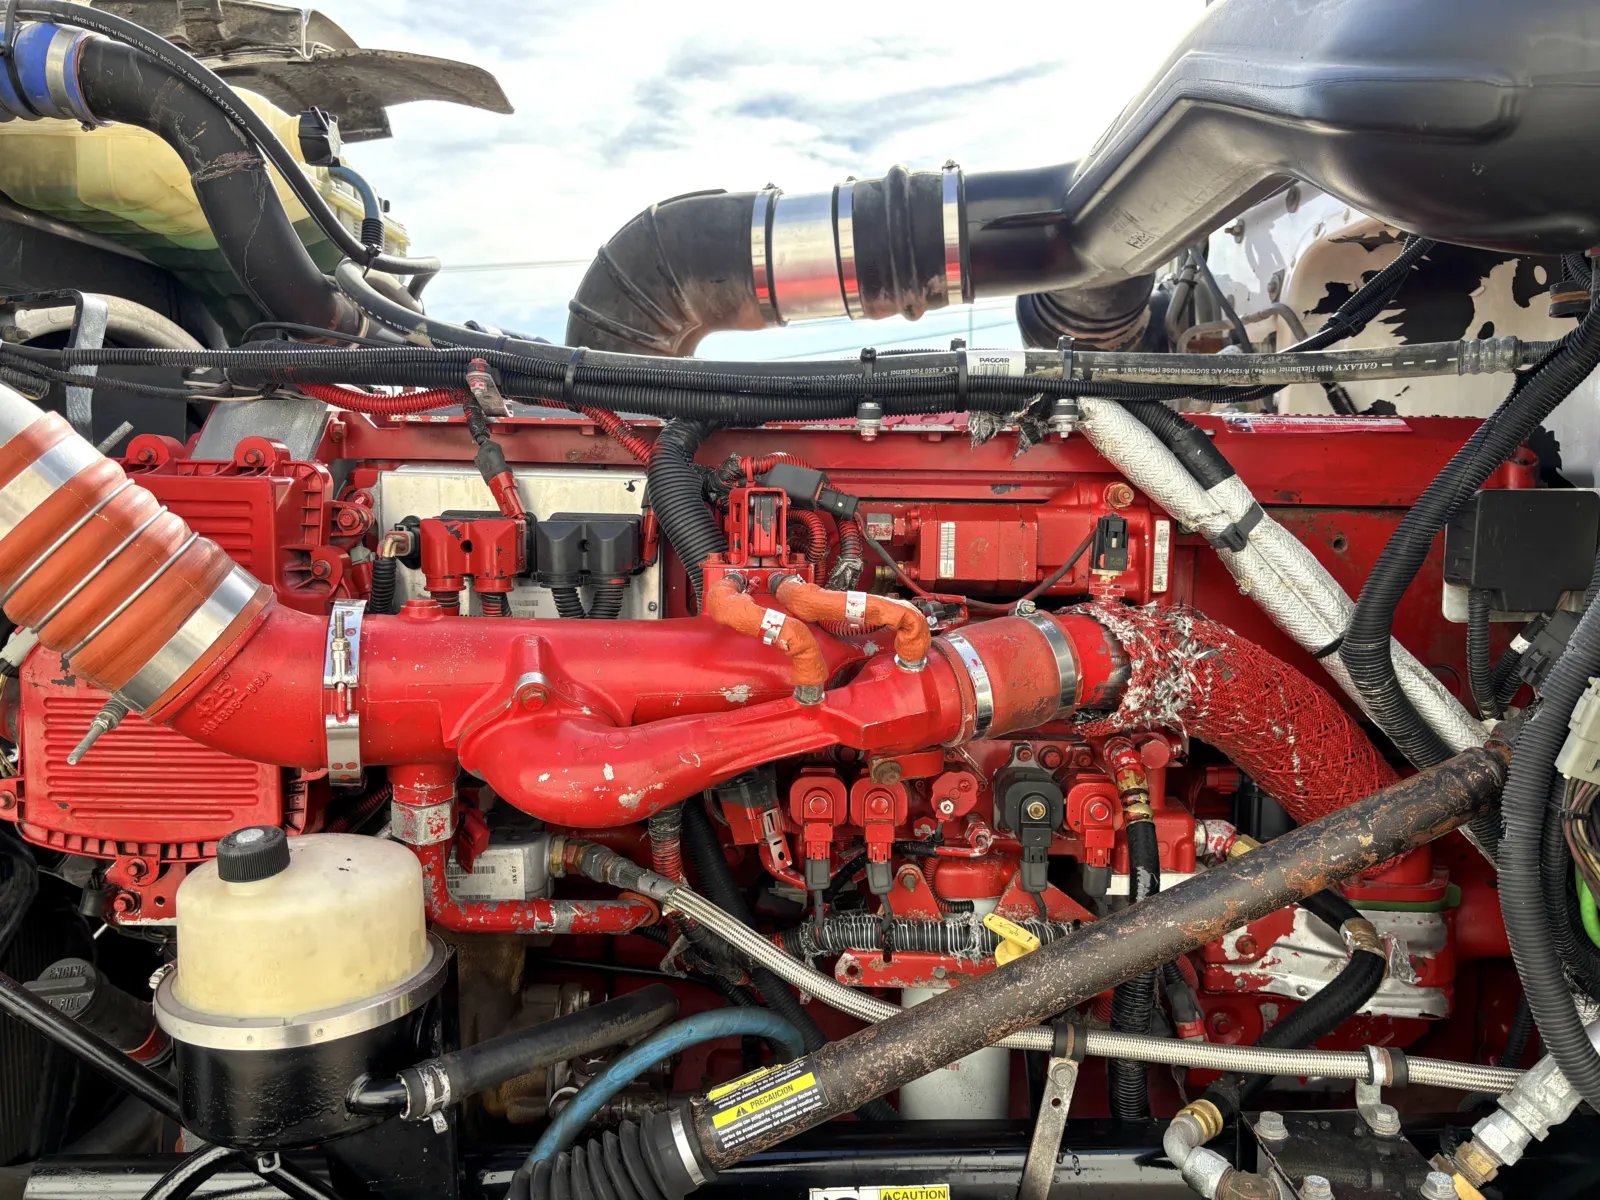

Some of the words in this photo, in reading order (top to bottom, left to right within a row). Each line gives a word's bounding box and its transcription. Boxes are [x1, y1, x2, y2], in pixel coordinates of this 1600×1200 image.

[160, 54, 176, 68] HOSE
[213, 95, 246, 126] GALAXY
[1279, 365, 1315, 373] FlexBarrier
[1335, 362, 1378, 371] GALAXY
[50, 964, 87, 979] ENGINE
[60, 996, 81, 1011] FILL
[750, 1084, 794, 1110] PRECAUCION
[892, 1190, 946, 1200] CAUTION
